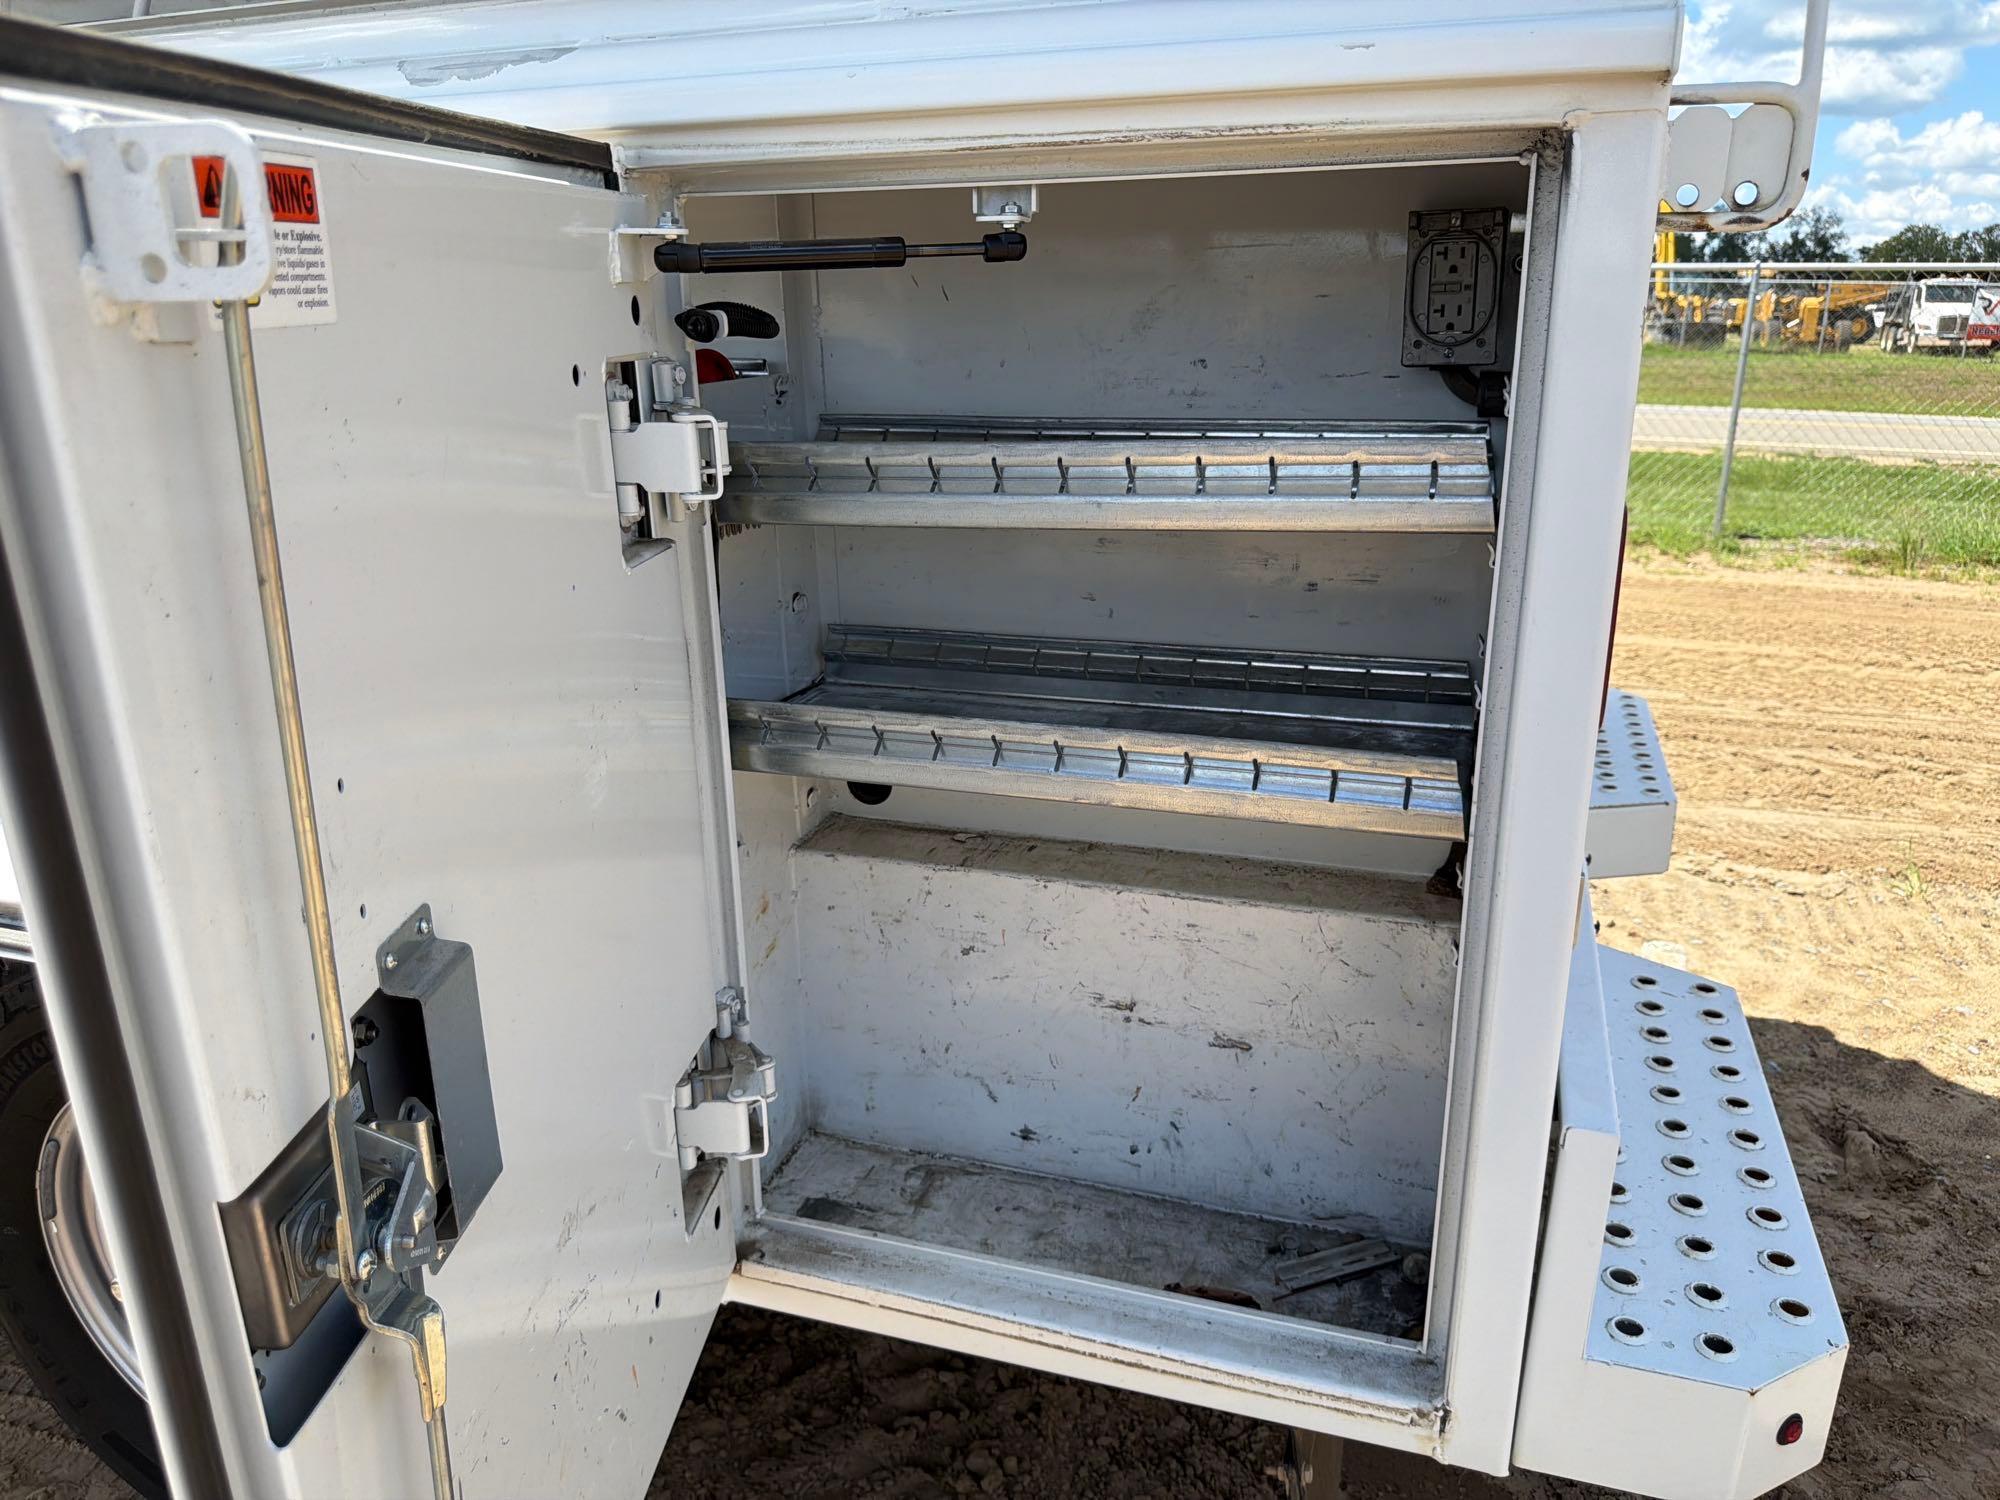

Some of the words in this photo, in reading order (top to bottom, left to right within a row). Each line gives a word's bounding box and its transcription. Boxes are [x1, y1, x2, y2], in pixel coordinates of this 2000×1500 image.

[265, 172, 314, 215] NING
[290, 229, 323, 244] Explosive.
[276, 245, 296, 257] ry/store
[297, 244, 324, 256] flammable
[274, 272, 290, 282] ented
[286, 285, 302, 295] could
[302, 287, 316, 295] cause
[317, 284, 329, 295] fires
[297, 301, 303, 309] or
